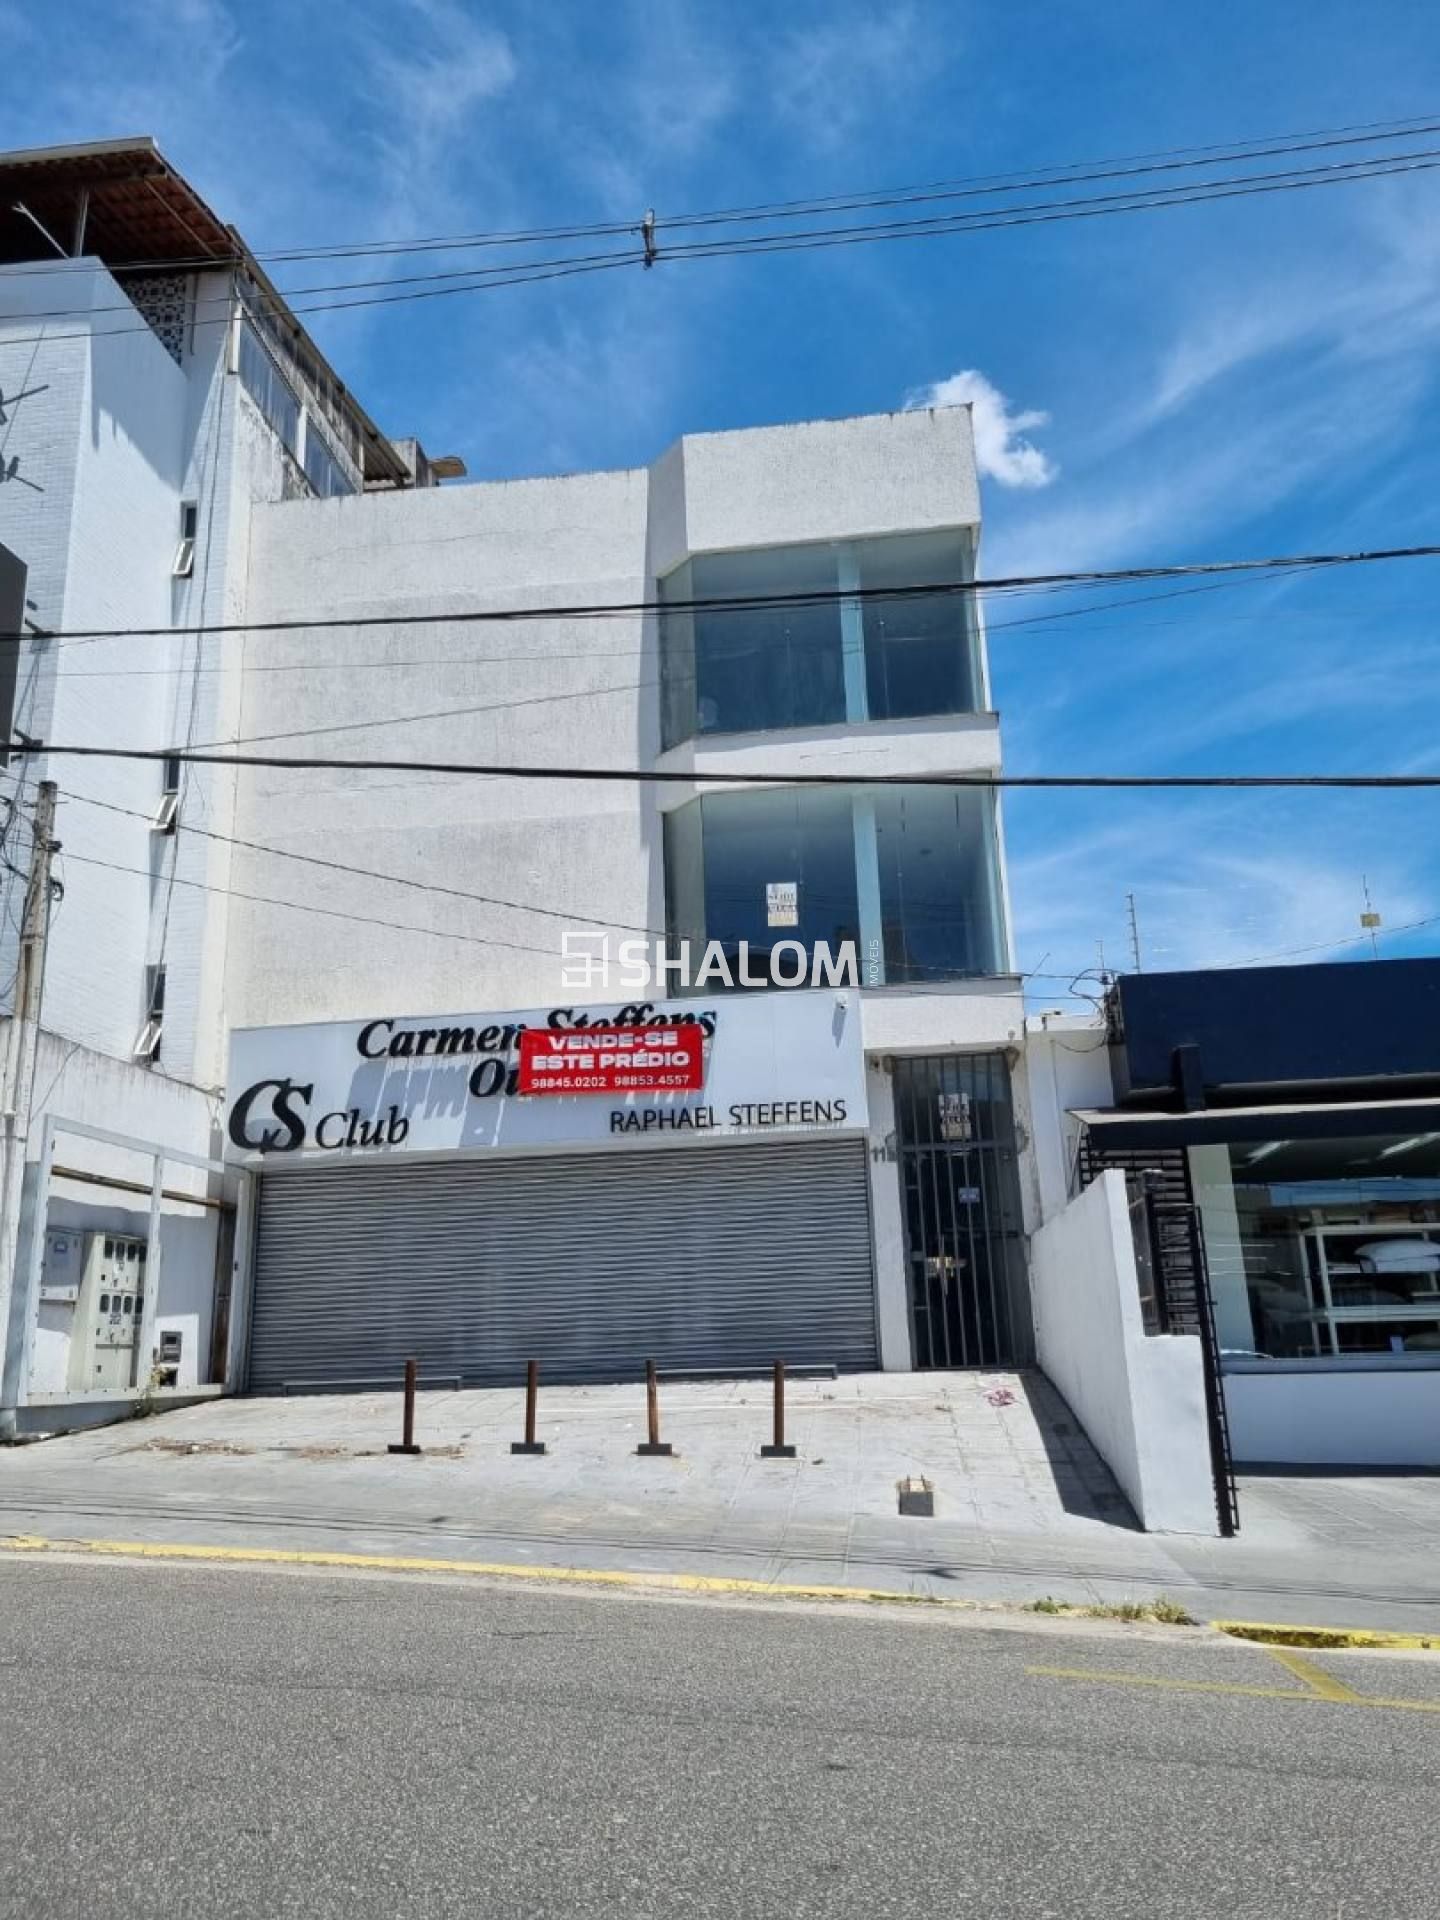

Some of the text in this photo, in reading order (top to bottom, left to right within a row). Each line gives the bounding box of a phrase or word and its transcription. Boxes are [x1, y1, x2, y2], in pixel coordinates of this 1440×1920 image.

[357, 1019, 527, 1058] Carmen
[549, 1031, 679, 1050] VENDE-SE
[531, 1048, 691, 1071] ESTE PRÉDIO
[531, 1074, 691, 1089] 98845.0202 98853.4557
[315, 1104, 410, 1149] Club
[610, 1100, 848, 1132] RAPHAEL STEFFENS
